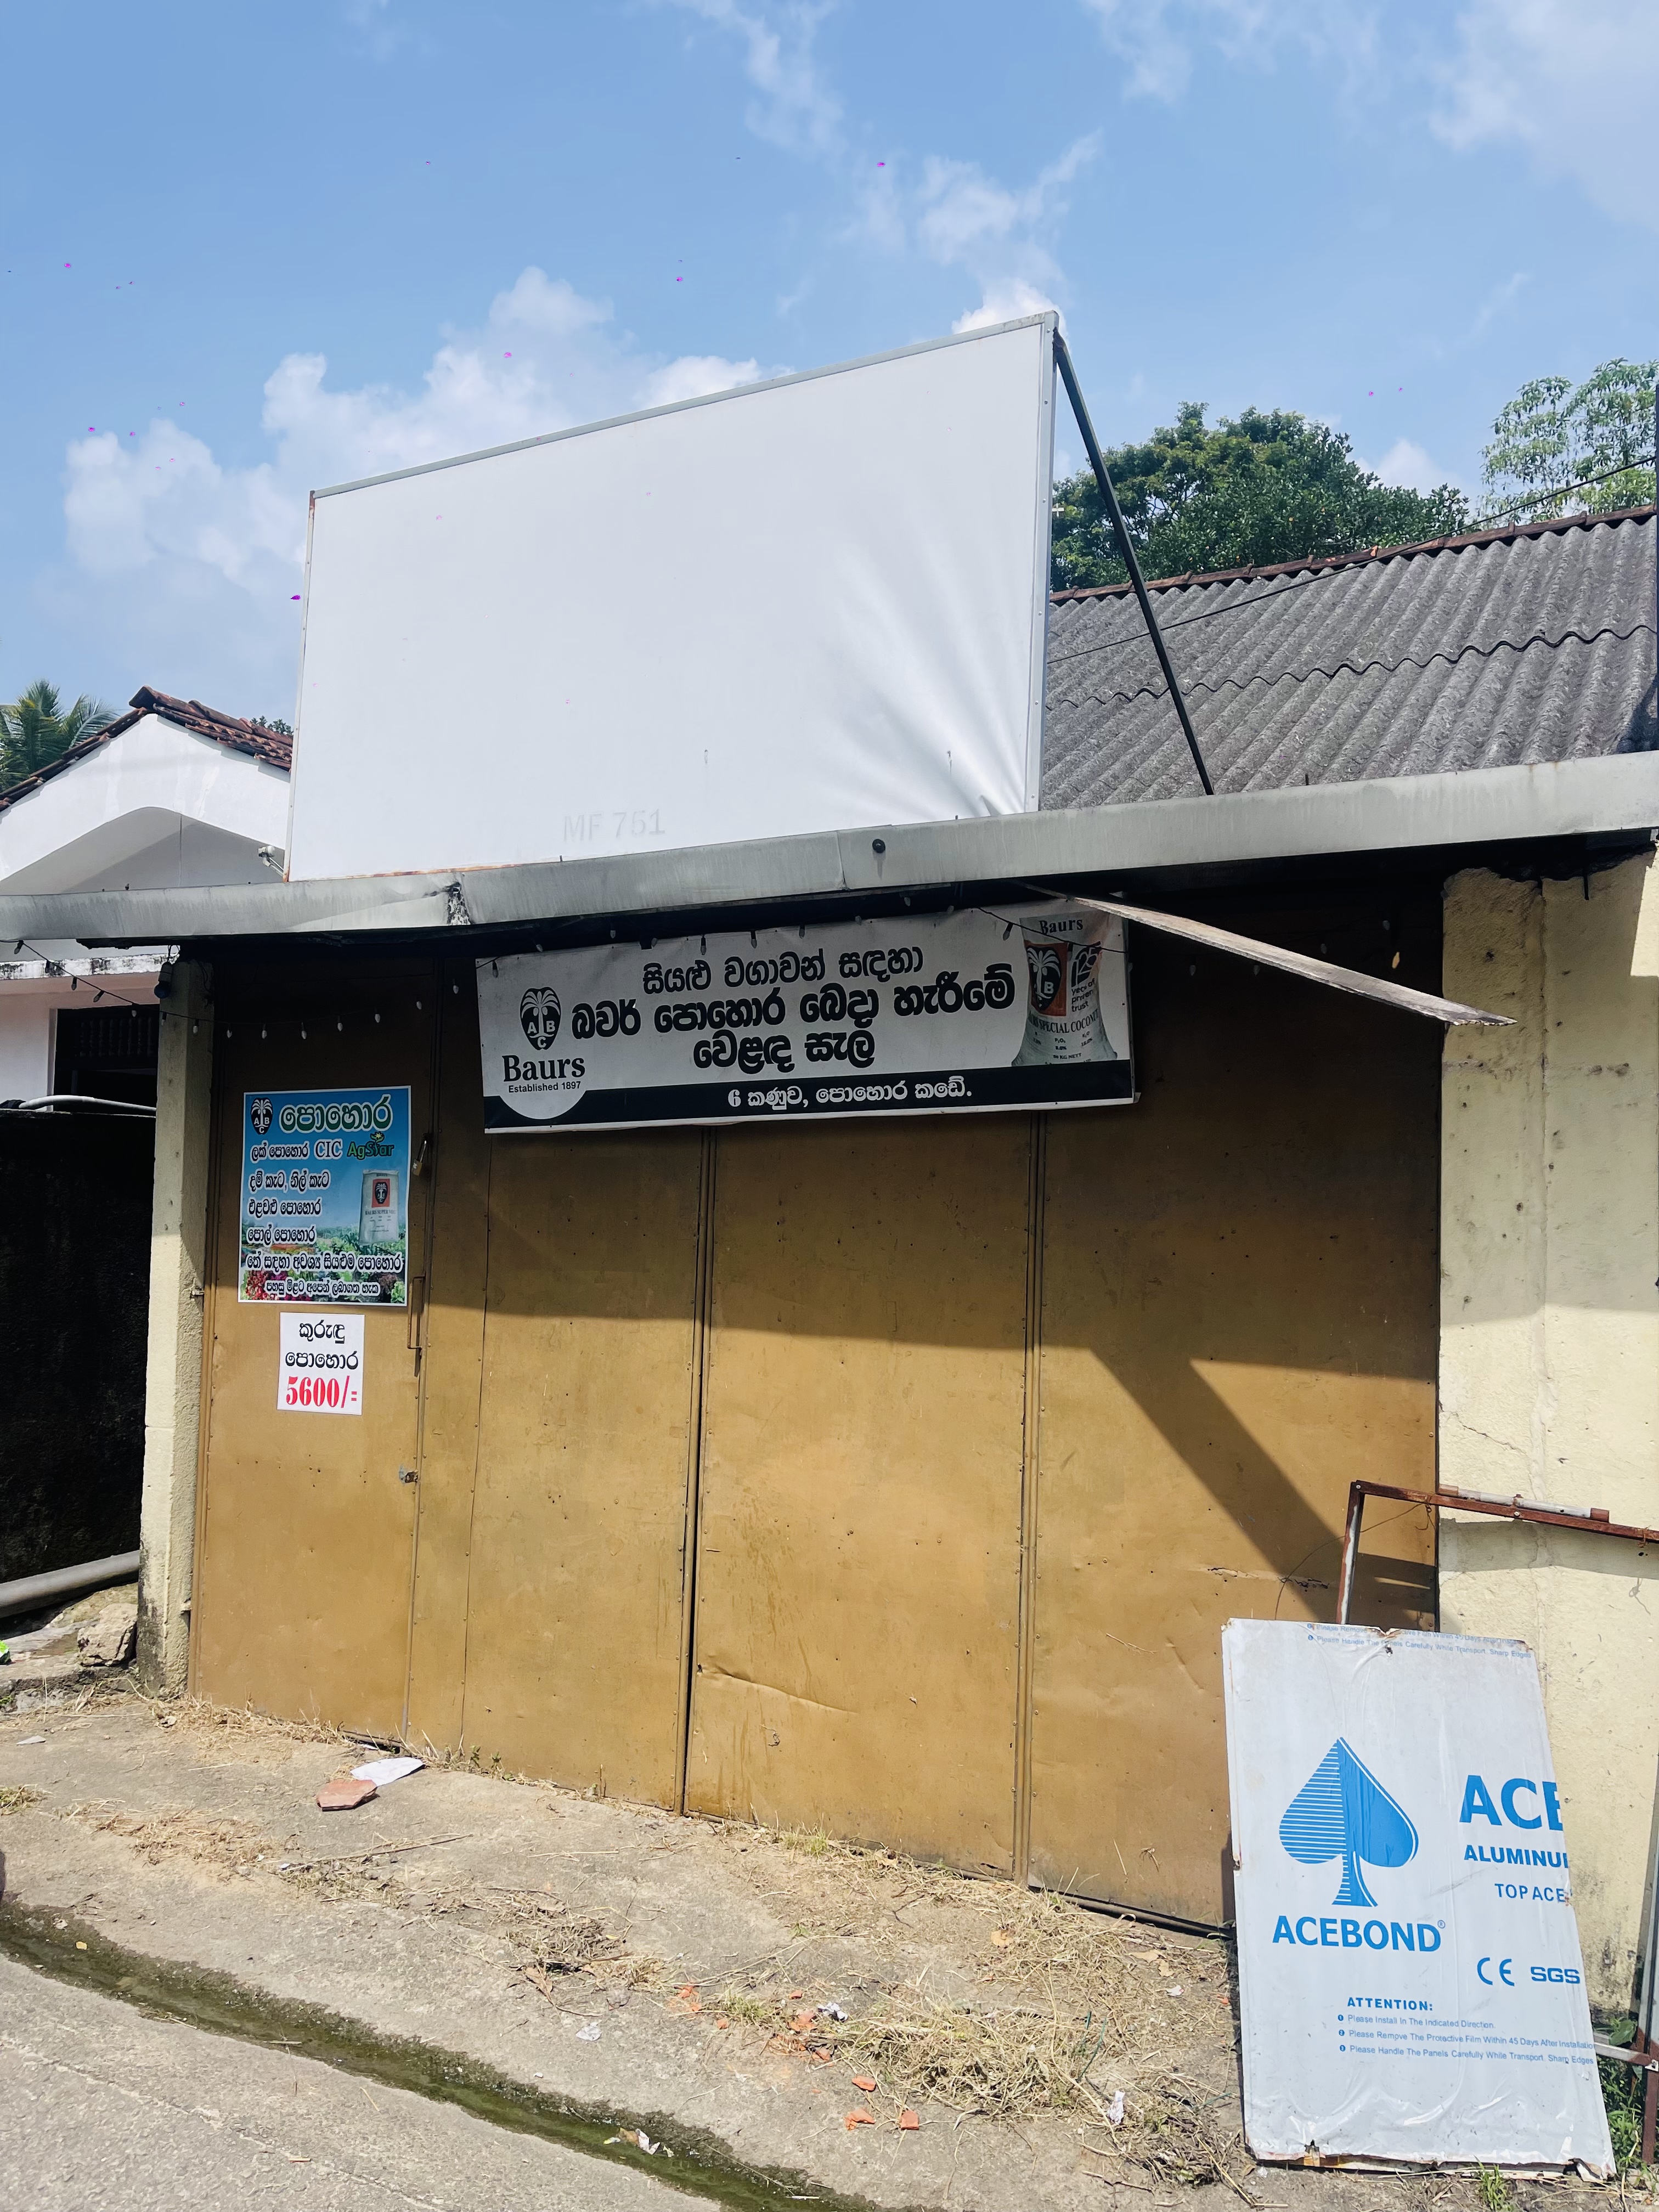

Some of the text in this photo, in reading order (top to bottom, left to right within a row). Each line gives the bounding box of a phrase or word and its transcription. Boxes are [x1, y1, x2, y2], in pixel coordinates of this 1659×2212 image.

[563, 814, 602, 842] MF
[1039, 919, 1084, 934] Baurs
[724, 949, 825, 988] වගාවන්
[838, 946, 924, 982] සඳහා
[654, 987, 786, 1033] පොහොර
[800, 983, 879, 1028] බෙදා
[804, 1030, 875, 1069] සැල
[503, 1054, 585, 1082] Baurs
[508, 1081, 581, 1093] Established 1897
[727, 1089, 742, 1107] 6
[816, 1080, 908, 1103] පොහොර
[280, 1095, 392, 1132] පොහොර
[252, 1138, 394, 1161] ලක් පොහොර CIC AgStar
[309, 1171, 329, 1188] කැට
[280, 1199, 321, 1215] පොහොර
[248, 1224, 315, 1245] පොල් පොහොර
[264, 1256, 290, 1273] සඳහා
[358, 1254, 401, 1271] පොහොර
[285, 1351, 358, 1370] පොහොර
[286, 1375, 357, 1408] 5600/=
[1406, 1641, 1434, 1650] Carefully
[1489, 1649, 1509, 1657] Sharp
[1511, 1650, 1532, 1659] Edges
[1494, 1883, 1528, 1899] TOP
[1530, 1966, 1581, 1984] SGS
[1347, 1997, 1433, 2011] ATTENTION:
[1348, 2015, 1373, 2023] Please
[1375, 2016, 1397, 2024] Install
[1426, 2018, 1459, 2027] Indicated
[1349, 2030, 1374, 2038] Please
[1377, 2032, 1408, 2040] Remove
[1427, 2034, 1464, 2042] Protective
[1465, 2035, 1481, 2044] Film
[1483, 2036, 1507, 2044] Within
[1520, 2038, 1539, 2047] Days
[1350, 2045, 1375, 2053] Please
[1379, 2047, 1404, 2055] Handle
[1423, 2049, 1448, 2057] Panels
[1452, 2050, 1483, 2060] Carefully
[1486, 2051, 1507, 2059] While
[1548, 2055, 1570, 2064] Sharp
[1572, 2056, 1594, 2065] Edges
